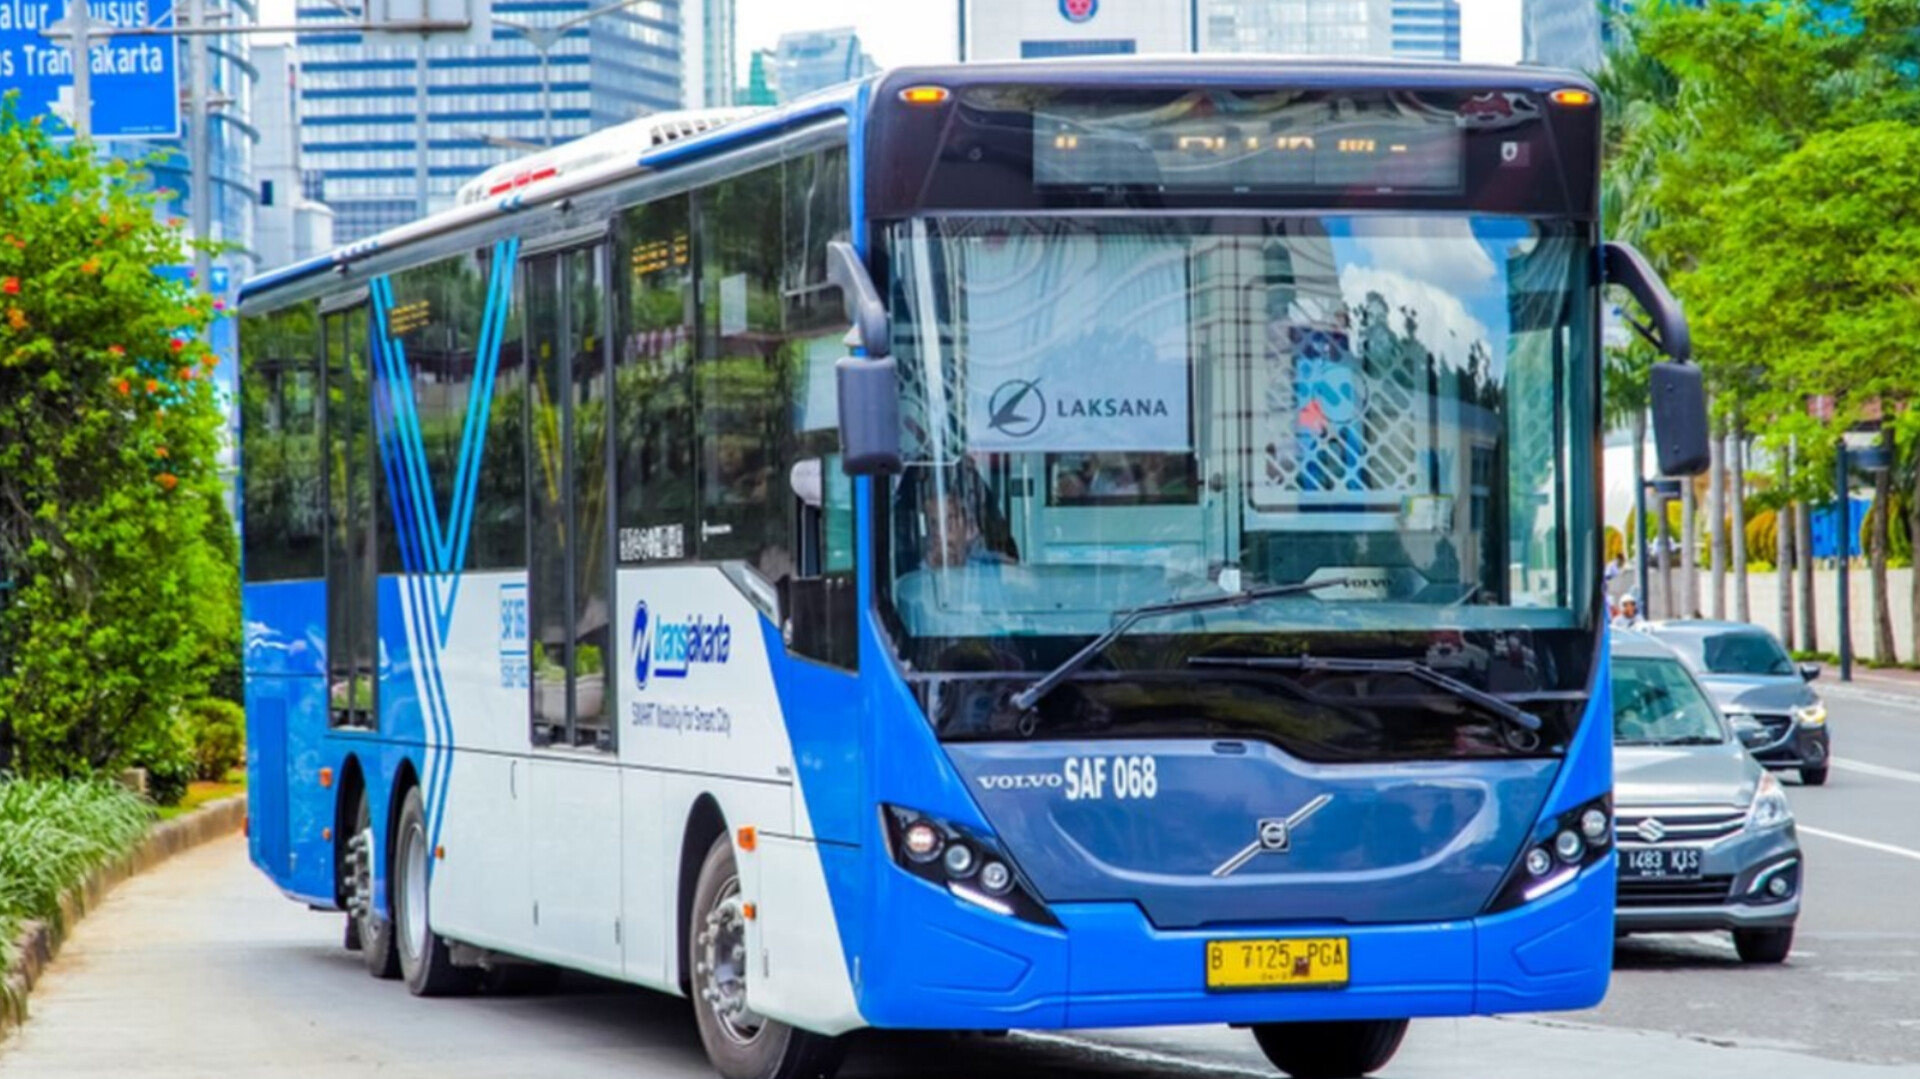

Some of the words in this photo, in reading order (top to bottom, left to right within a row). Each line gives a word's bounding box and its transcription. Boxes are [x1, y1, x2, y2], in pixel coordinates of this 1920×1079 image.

[63, 0, 148, 29] usus
[0, 49, 14, 76] s
[23, 42, 163, 77] Tranakarta
[1056, 398, 1168, 418] LAKSANA
[653, 614, 731, 678] transjakarta
[978, 773, 1063, 789] VOLVO
[1064, 756, 1107, 801] SAF
[1113, 755, 1158, 799] 068
[1211, 946, 1224, 970] B
[1241, 943, 1291, 969] 7125
[1307, 941, 1344, 967] PGA
